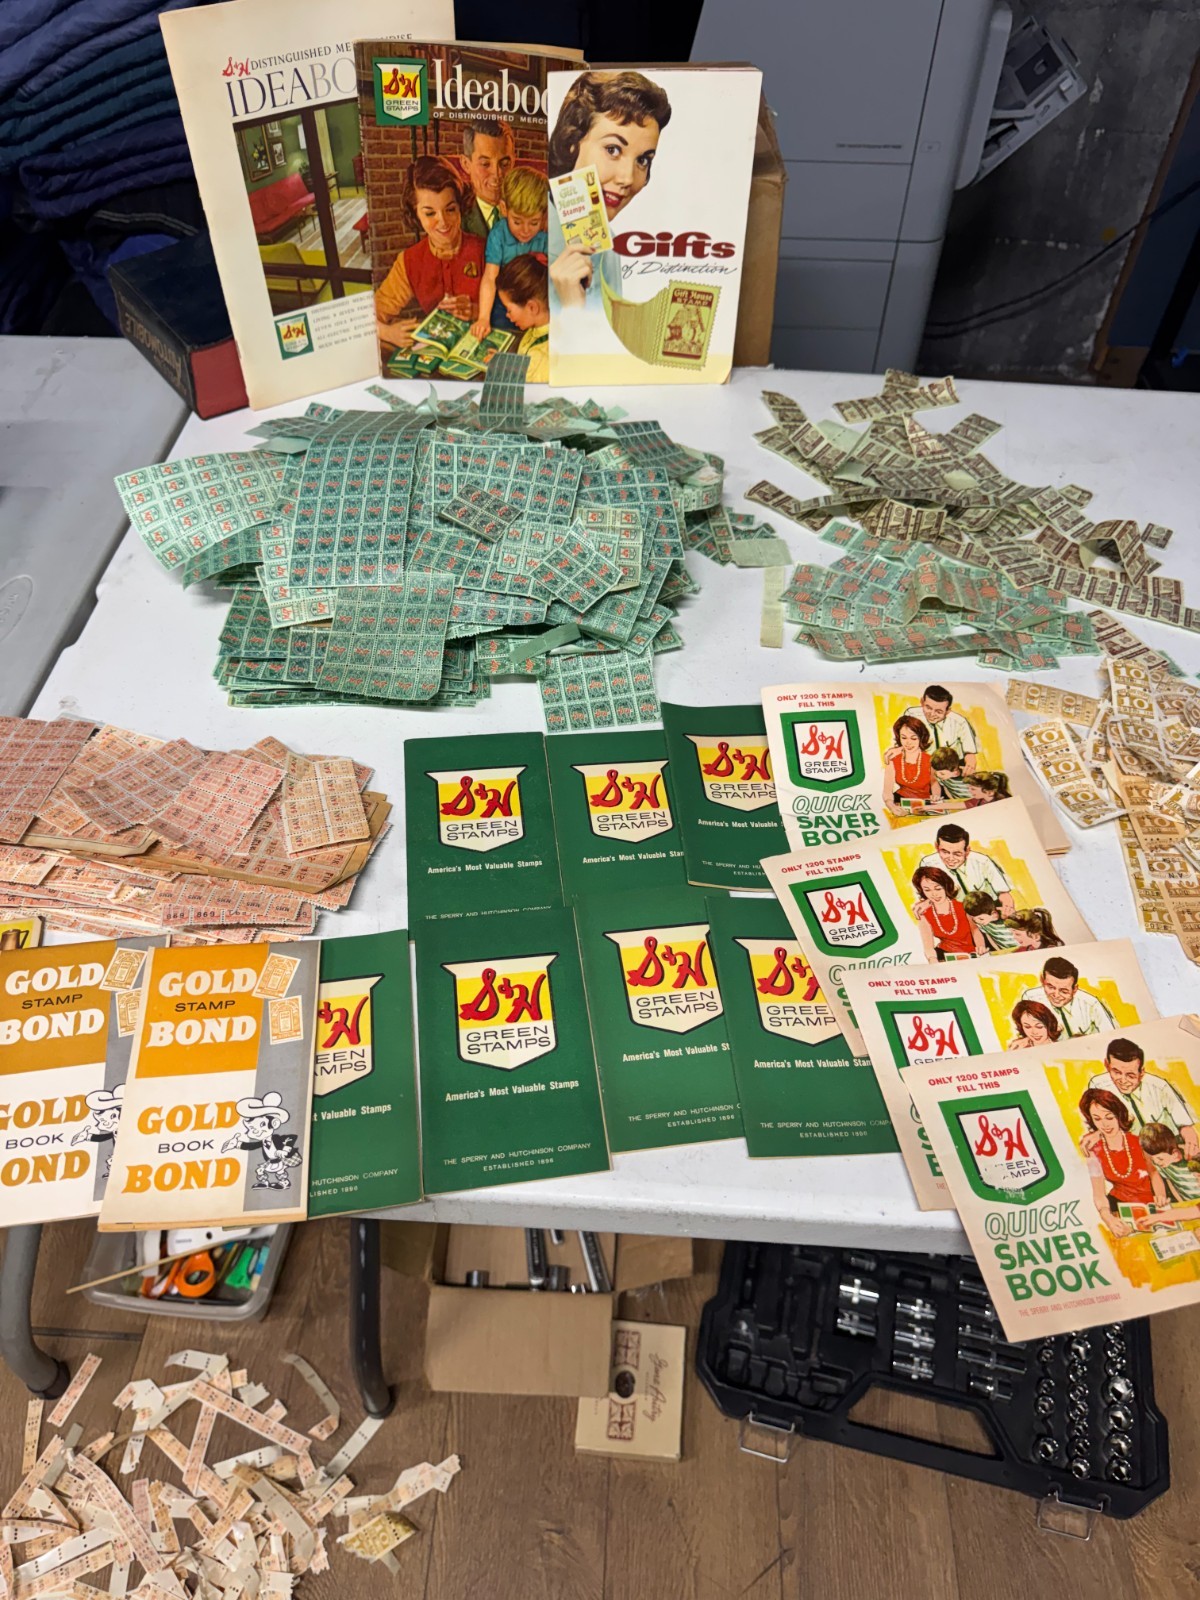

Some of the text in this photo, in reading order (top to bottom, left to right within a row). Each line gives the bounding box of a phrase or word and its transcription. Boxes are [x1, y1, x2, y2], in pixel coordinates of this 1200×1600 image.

[251, 46, 331, 70] DISTINGUISHED
[383, 68, 419, 98] S&H
[449, 113, 514, 122] DISTINGUISHED
[562, 205, 585, 217] Stamps
[612, 232, 736, 258] Gifts
[622, 261, 737, 279] of Distinction
[674, 289, 712, 301] Gift House
[1120, 667, 1145, 680] 10
[1124, 698, 1149, 710] 10
[801, 725, 844, 760] S&H
[1028, 729, 1059, 747] 10
[703, 742, 771, 780] S&H
[1046, 760, 1076, 777] 10
[440, 776, 516, 818] S&H
[590, 769, 661, 810] S&H
[792, 794, 872, 815] QUICK
[597, 811, 665, 822] GREEN
[698, 819, 729, 827] America's
[732, 820, 748, 828] Most
[750, 820, 777, 828] Valuable
[797, 813, 880, 829] SAVER
[447, 820, 517, 831] GREEN
[447, 828, 519, 840] STAMPS
[599, 820, 668, 831] STAMPS
[428, 865, 461, 874] America's
[485, 862, 514, 870] Valuable
[518, 860, 542, 868] Stamps
[582, 856, 615, 864] America's
[781, 864, 802, 873] ONLY
[827, 854, 861, 865] STAMPS
[805, 869, 823, 877] FILL
[821, 892, 869, 925] S&H
[829, 923, 875, 936] GREEN
[831, 929, 878, 942] STAMPS
[626, 936, 708, 989] S&H
[5, 962, 105, 995] GOLD
[158, 967, 257, 998] GOLD
[895, 979, 916, 987] 1200
[919, 977, 957, 986] STAMPS
[22, 994, 83, 1010] STAMP
[459, 968, 546, 1022] S&H
[636, 991, 714, 1007] GREEN
[175, 1000, 235, 1012] STAMP
[639, 1002, 718, 1019] STAMPS
[0, 1008, 105, 1046] BOND
[146, 1015, 257, 1048] BOND
[467, 1025, 548, 1042] GREEN
[908, 1016, 960, 1056] S&H
[468, 1037, 550, 1055] STAMPS
[623, 1050, 660, 1062] America's
[664, 1048, 683, 1058] Most
[685, 1045, 718, 1055] Valuable
[754, 1059, 791, 1068] America's
[795, 1059, 814, 1068] Most
[818, 1059, 849, 1067] Valuable
[928, 1068, 1020, 1086] ONLY 1200 STAMPS
[445, 1079, 579, 1102] America's Most Valuable Stamps
[957, 1081, 1000, 1093] FILL THIS
[137, 1100, 240, 1135] GOLD
[321, 1109, 356, 1121] Valuable
[361, 1104, 392, 1115] Stamps
[645, 1112, 670, 1120] SPERRY
[690, 1104, 734, 1114] HUTCHINSON
[668, 1116, 717, 1128] ESTABLISHED
[5, 1133, 64, 1149] BOOK
[975, 1115, 1029, 1160] S&H
[158, 1139, 214, 1154] BOOK
[461, 1154, 488, 1164] SPERRY
[491, 1152, 505, 1160] AND
[509, 1147, 554, 1158] HUTCHINSON
[558, 1143, 591, 1152] COMPANY
[484, 1160, 535, 1172] ESTABLISHED
[122, 1157, 241, 1194] BOND
[312, 1168, 399, 1186] HUTCHINSON COMPANY
[985, 1200, 1083, 1241] QUICK
[994, 1231, 1100, 1270] SAVER
[1005, 1260, 1112, 1301] BOOK
[1019, 1309, 1029, 1317] THE
[1031, 1306, 1049, 1316] SPERRY
[1051, 1304, 1062, 1312] AND
[1063, 1298, 1095, 1311] HUTCHINSON
